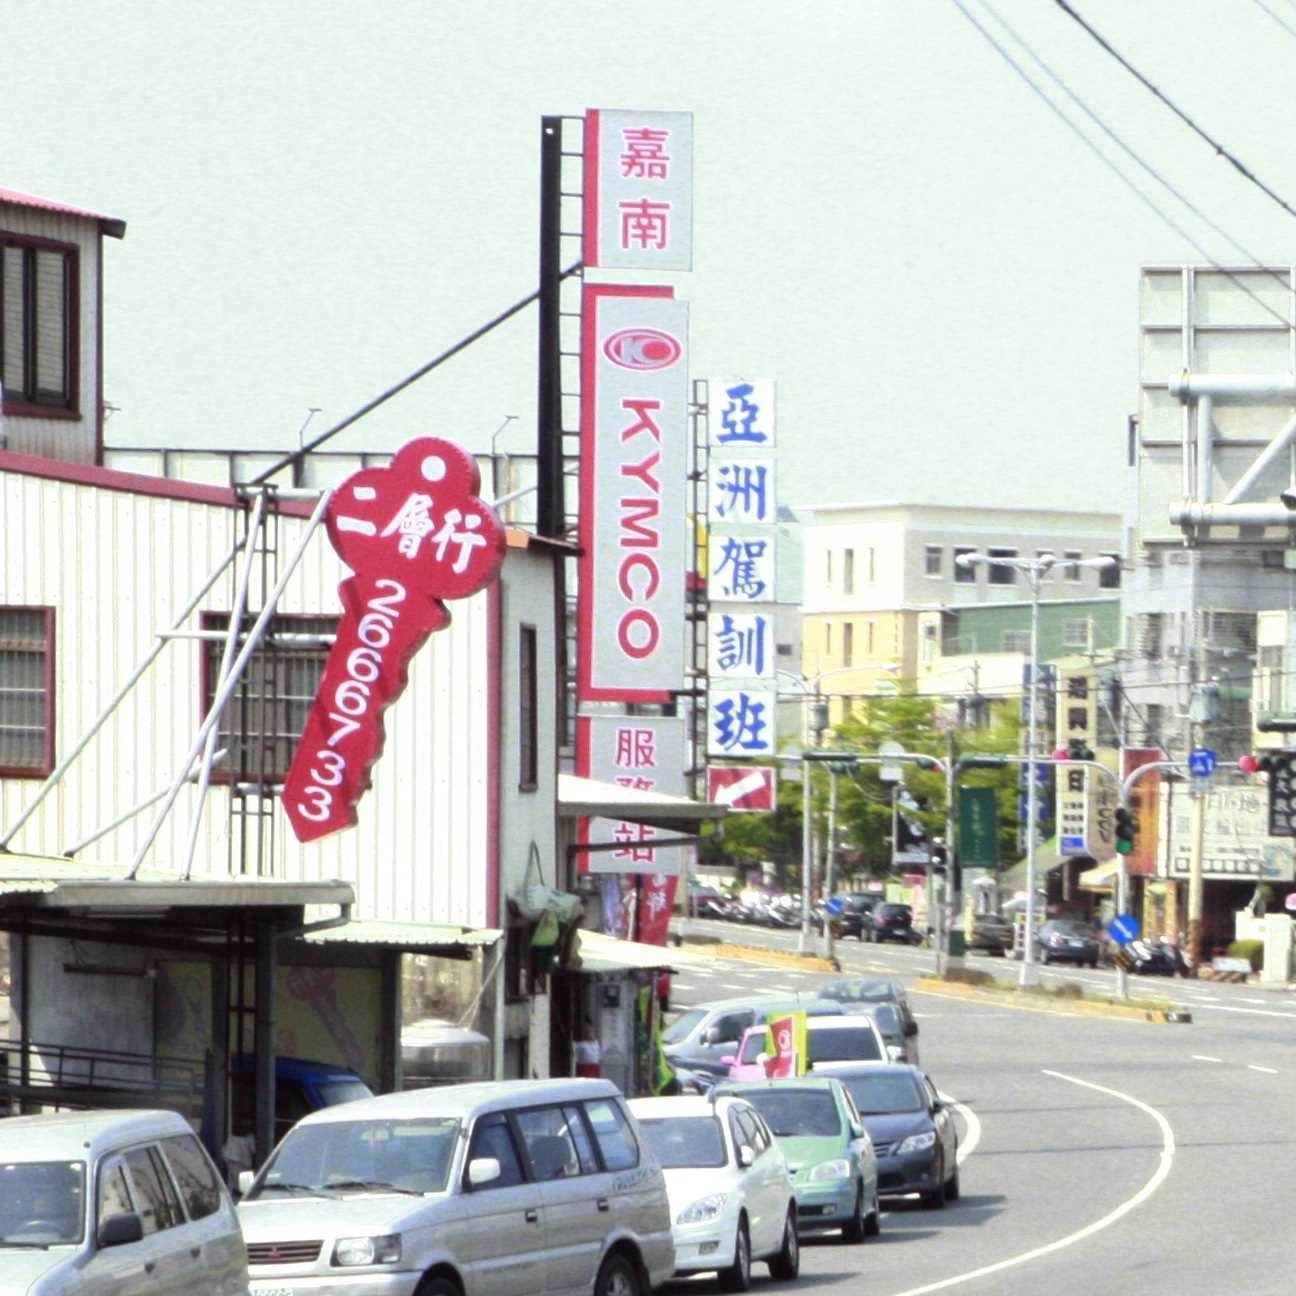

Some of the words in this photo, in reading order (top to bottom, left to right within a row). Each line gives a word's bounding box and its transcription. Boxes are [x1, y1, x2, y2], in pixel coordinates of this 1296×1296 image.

[619, 126, 671, 251] 嘉南
[617, 398, 662, 661] KYMCO
[716, 383, 768, 752] 亞洲駕訓班
[298, 578, 406, 823] 2666733
